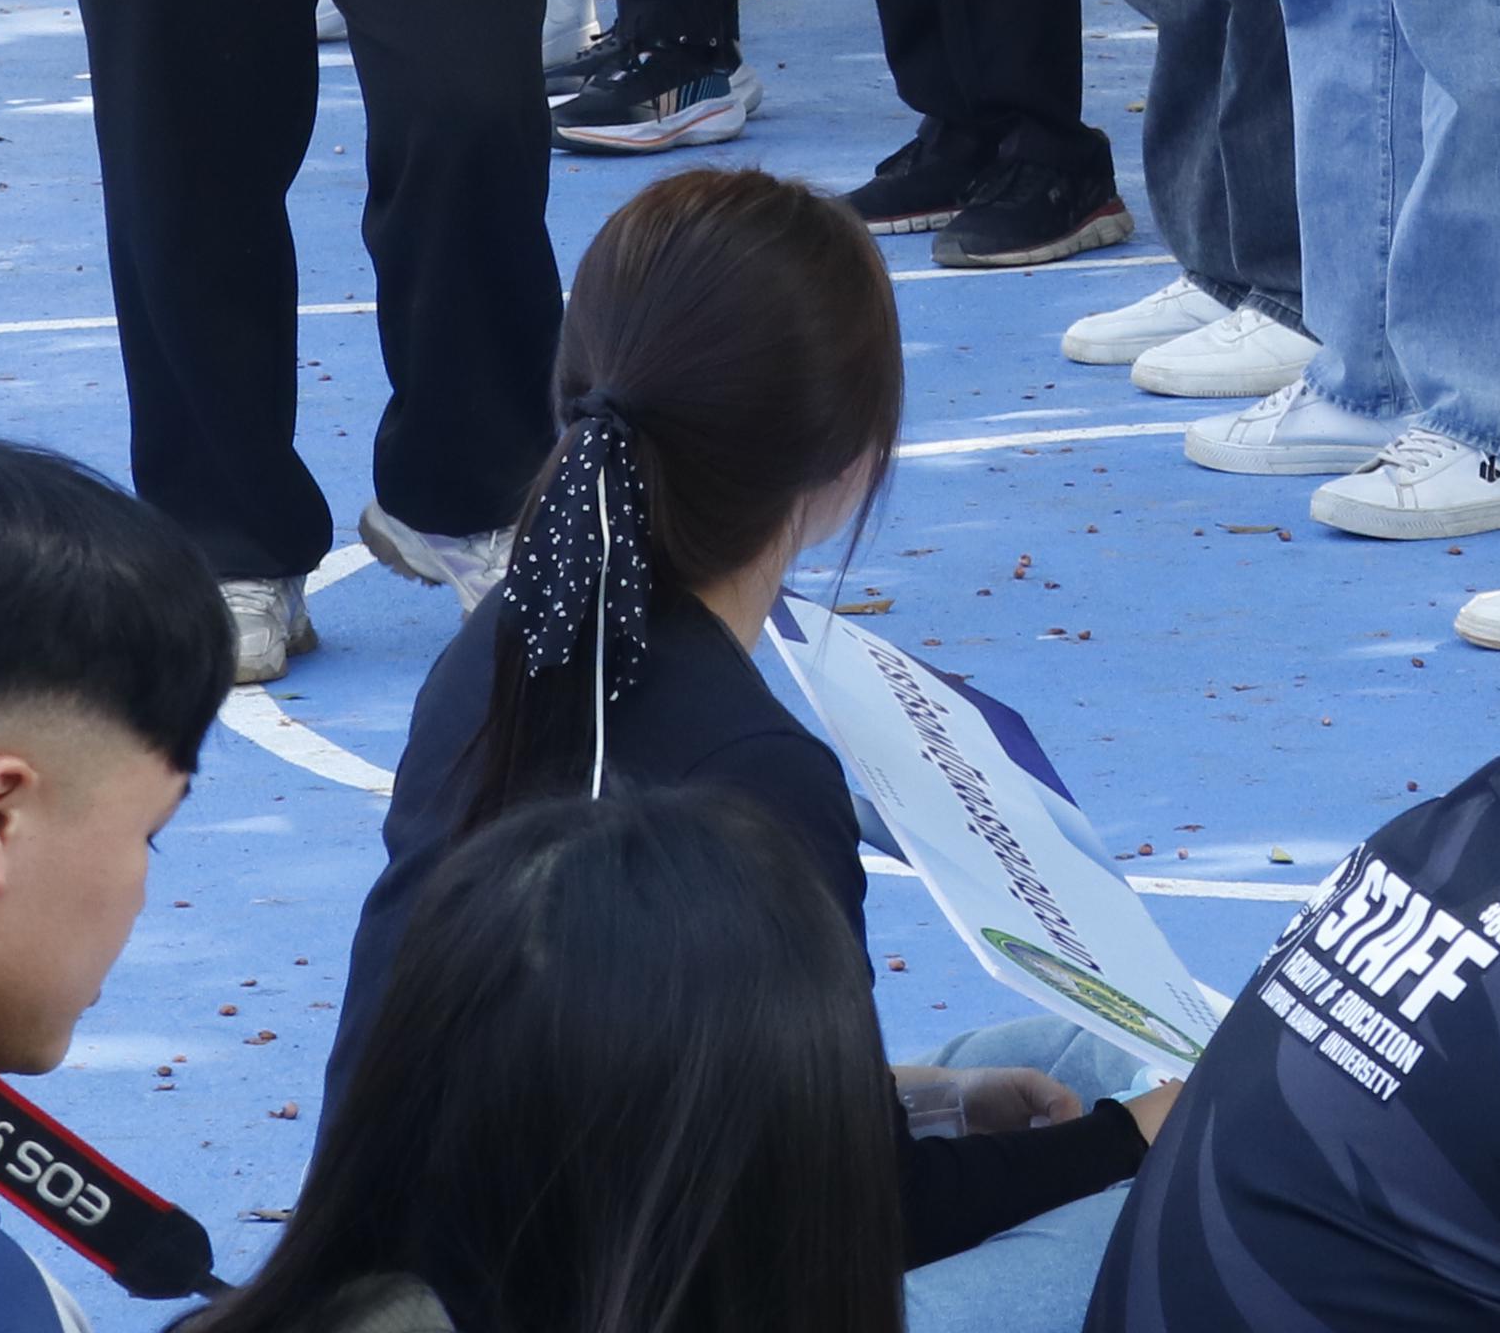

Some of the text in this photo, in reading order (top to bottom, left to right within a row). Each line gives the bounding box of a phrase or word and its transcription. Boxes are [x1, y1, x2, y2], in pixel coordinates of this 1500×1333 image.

[1314, 858, 1500, 1023] STAFF
[1281, 946, 1425, 1075] FACULTY OF EDUCATION
[1318, 1029, 1401, 1102] UNIVERSITY
[5, 1139, 112, 1226] EOS
